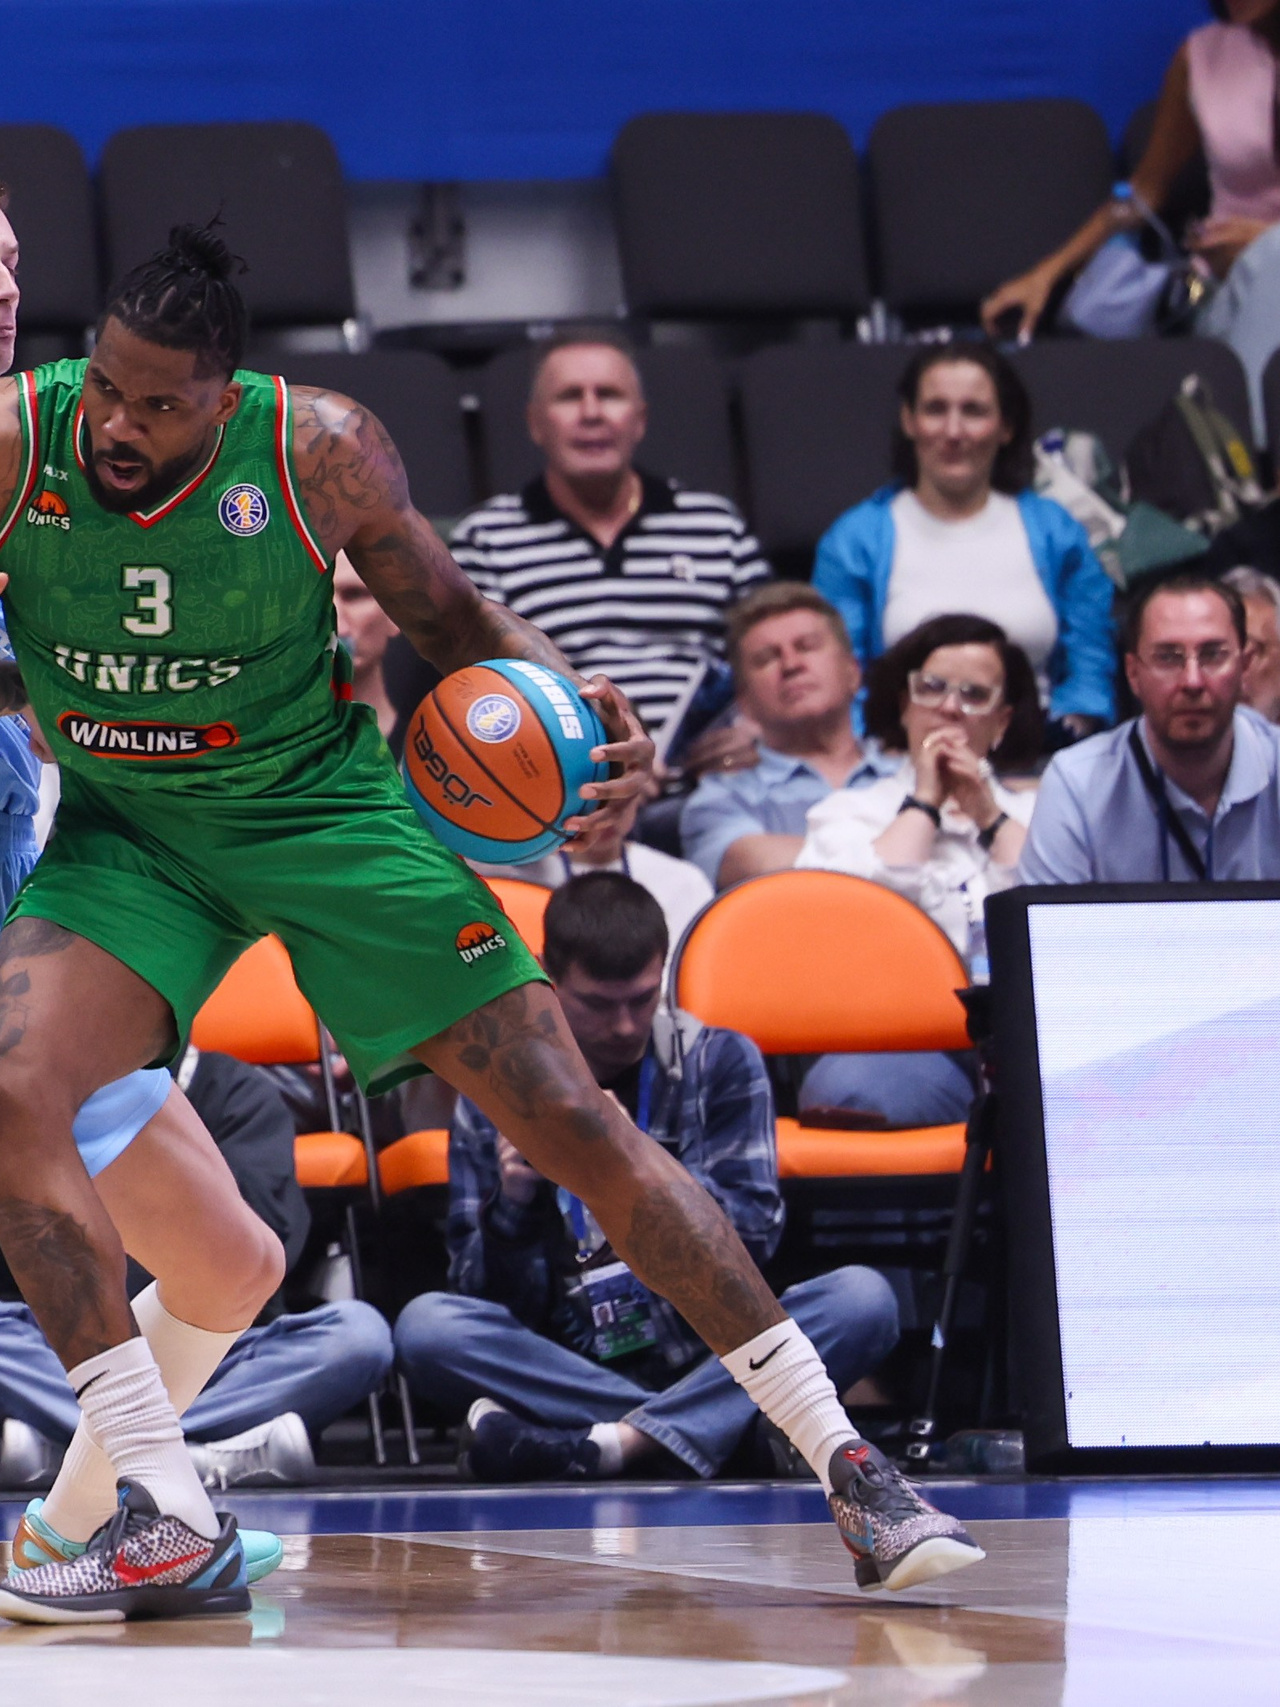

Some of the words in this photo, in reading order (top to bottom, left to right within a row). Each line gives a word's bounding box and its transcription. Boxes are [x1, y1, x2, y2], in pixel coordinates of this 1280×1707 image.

[27, 507, 71, 530] UNICS
[122, 565, 173, 638] 3
[54, 642, 242, 693] UNICS
[70, 720, 197, 752] WINLINE
[459, 934, 506, 963] UNICS
